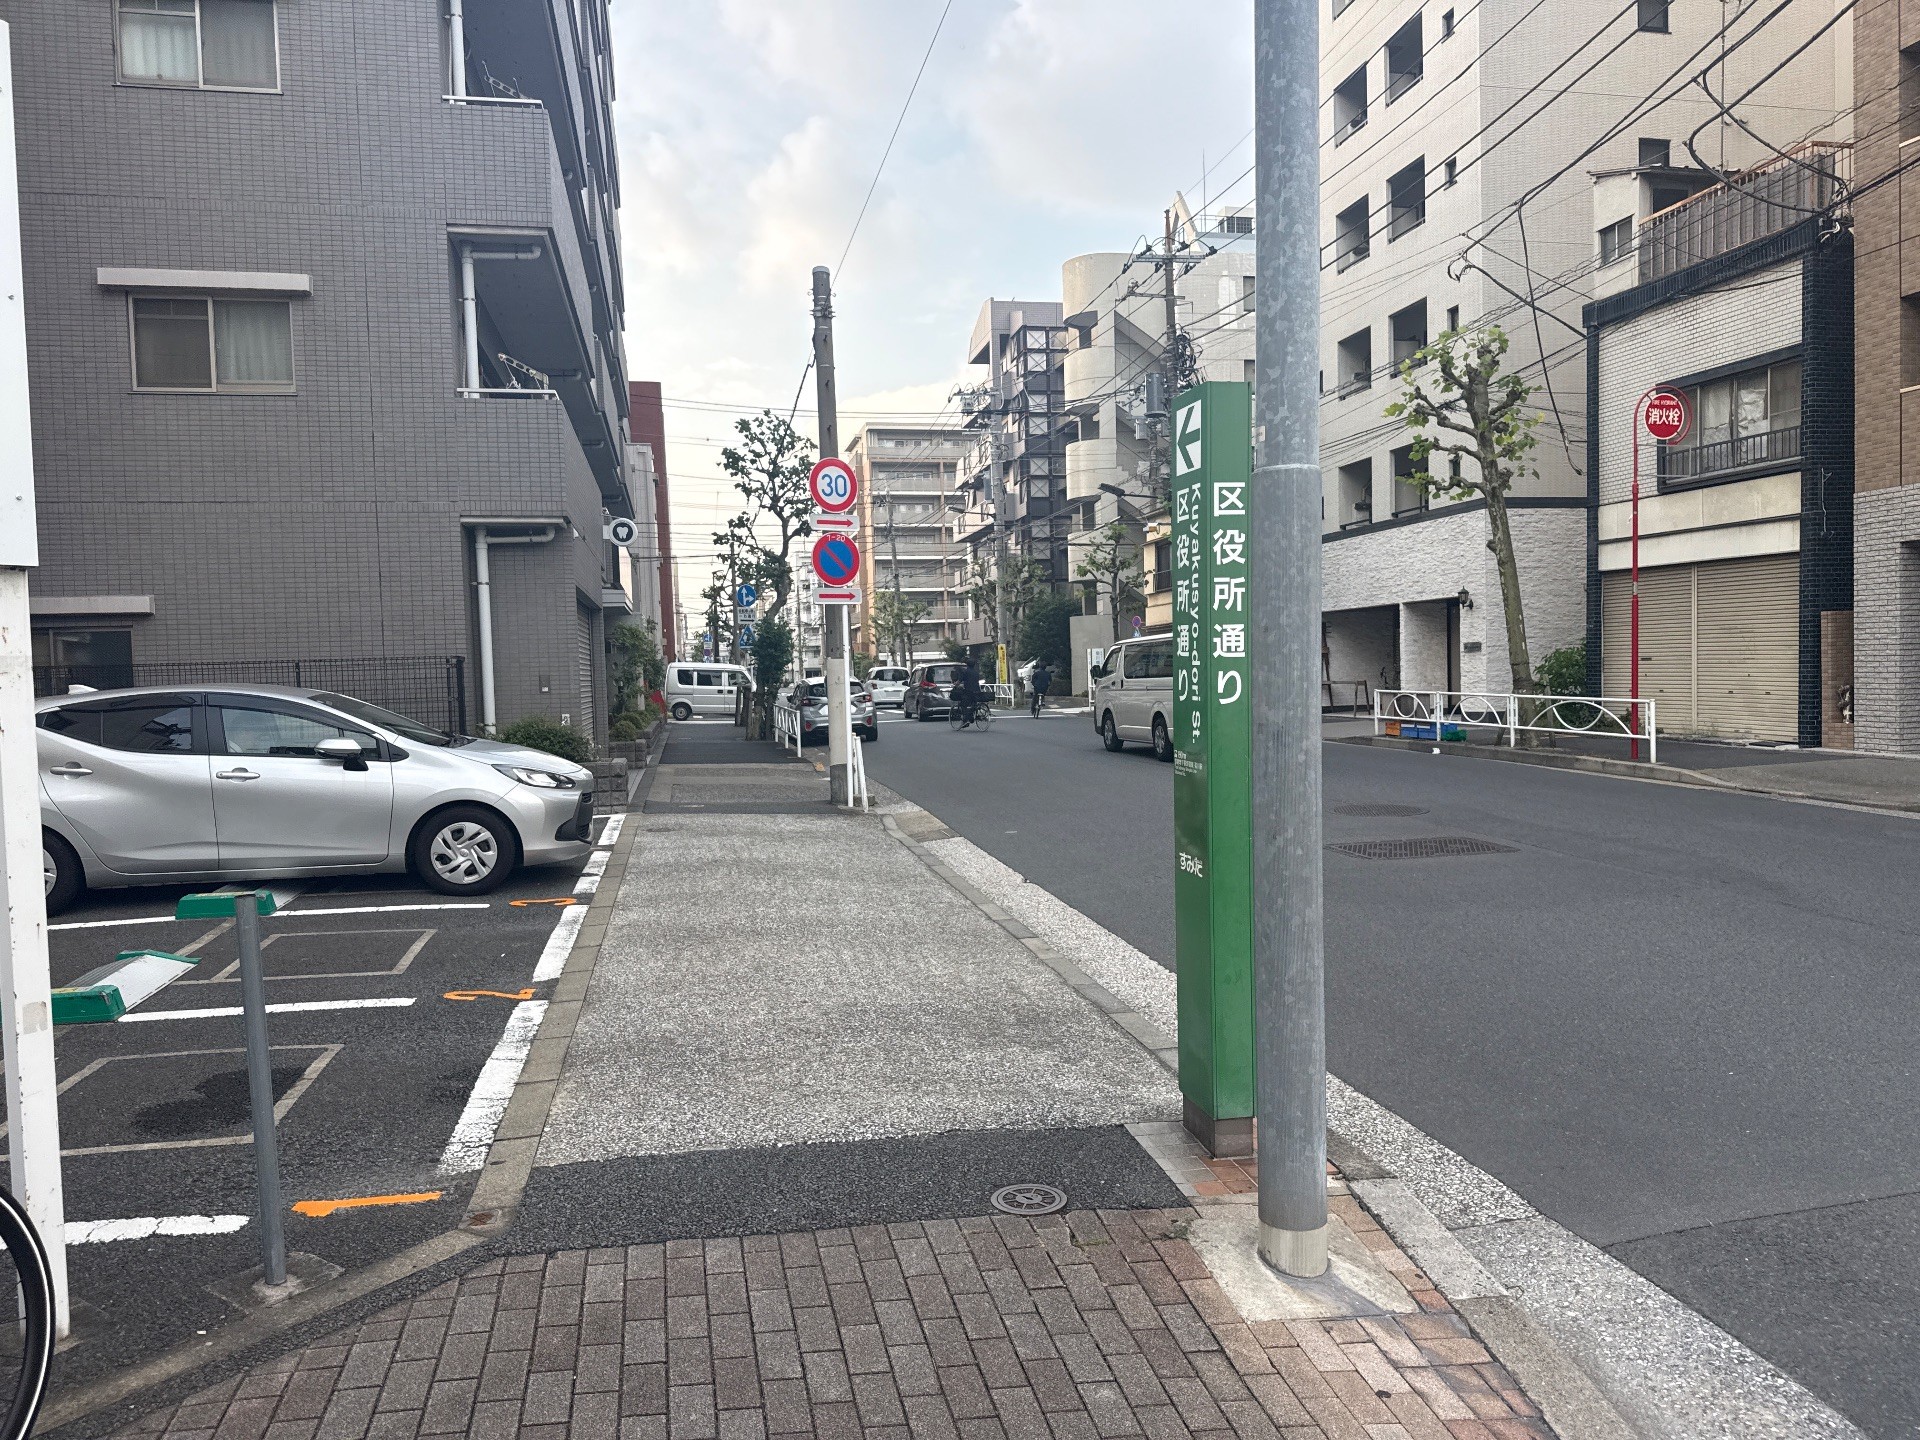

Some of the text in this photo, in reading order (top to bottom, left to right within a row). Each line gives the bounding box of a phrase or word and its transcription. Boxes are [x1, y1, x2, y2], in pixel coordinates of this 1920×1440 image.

[821, 473, 847, 497] 30
[1648, 408, 1680, 425] 消火栓
[1176, 487, 1190, 702] 区役所通り
[1190, 482, 1201, 744] Kuyakusyo-dori St.
[1212, 481, 1246, 705] 区役所通り
